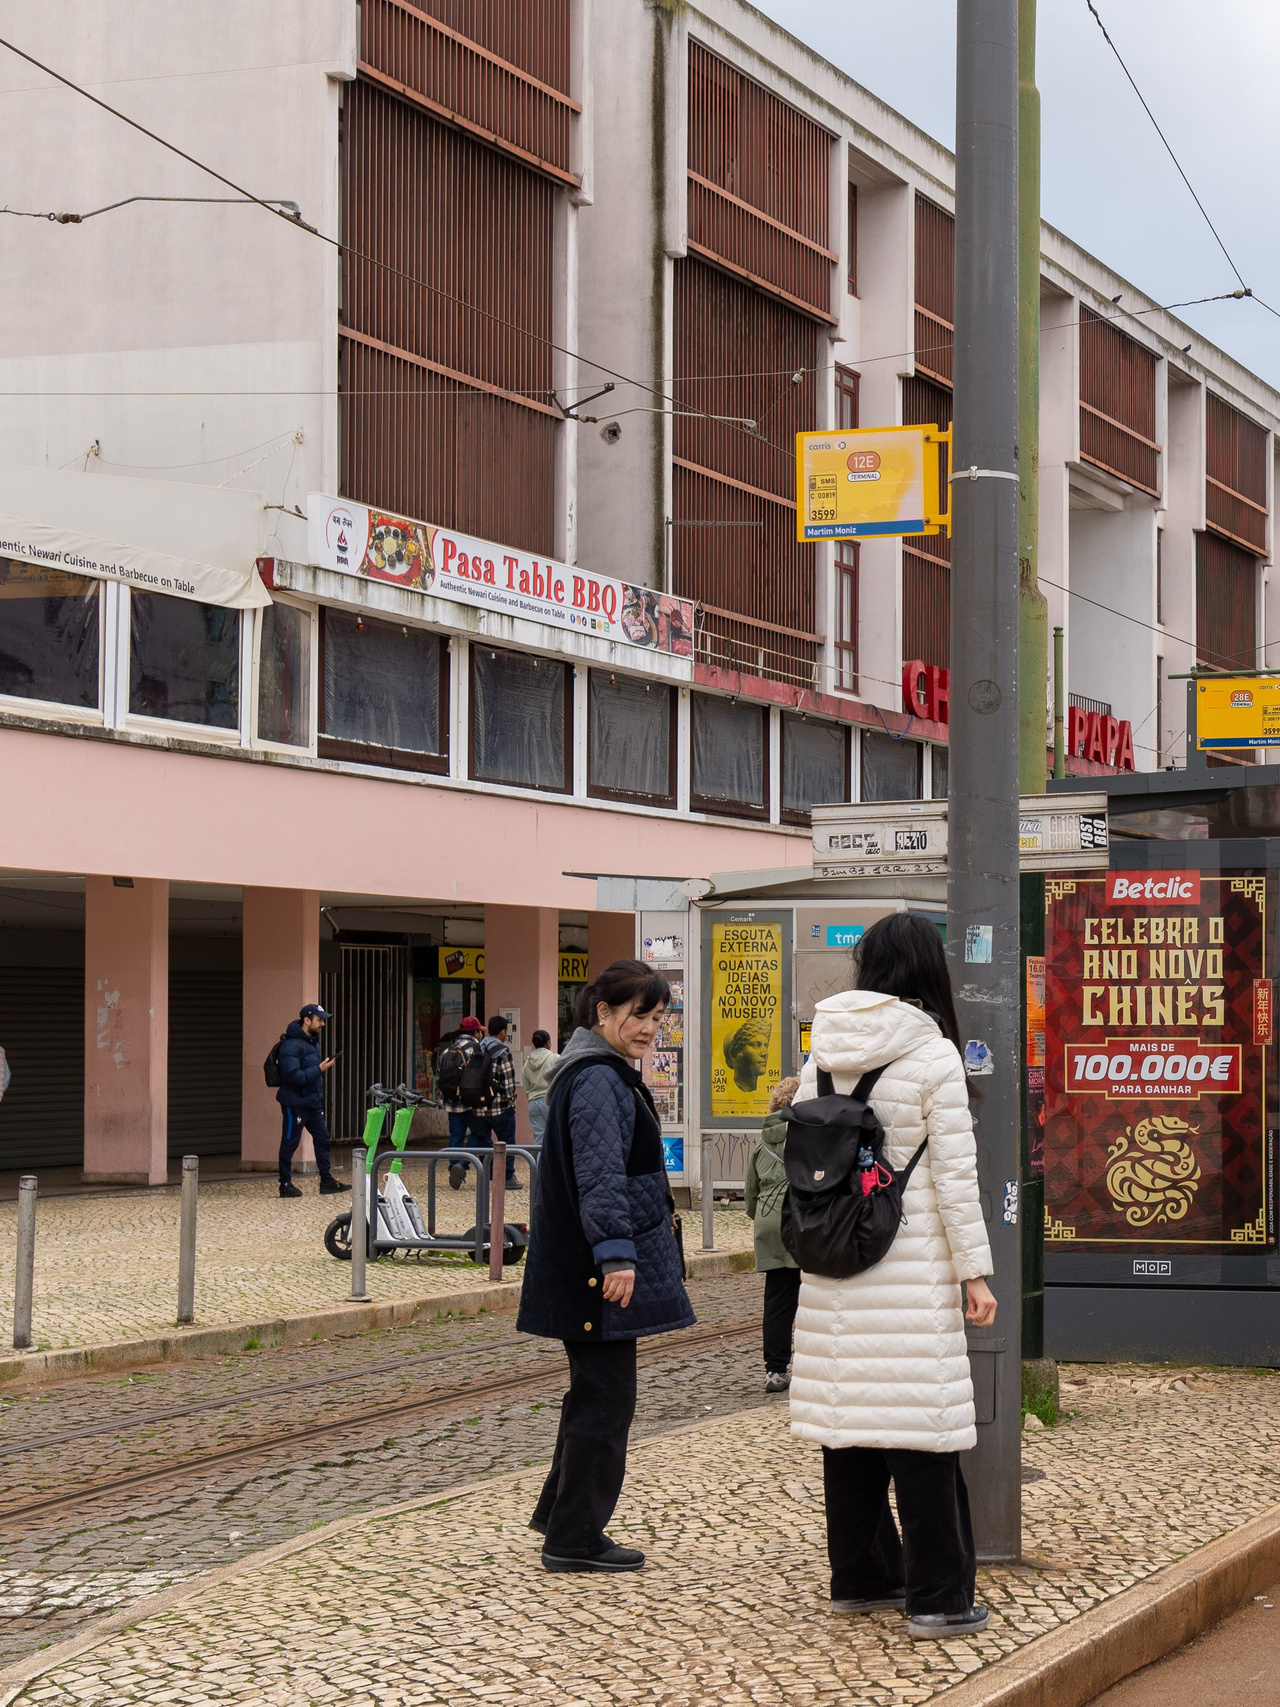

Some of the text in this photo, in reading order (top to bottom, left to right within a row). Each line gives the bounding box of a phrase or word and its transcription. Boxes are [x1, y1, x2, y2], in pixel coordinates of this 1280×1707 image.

[808, 441, 831, 451] carris
[853, 455, 875, 469] 12E
[850, 472, 879, 480] TERMINAL
[817, 491, 836, 499] 00819
[811, 509, 835, 521] 3599
[807, 526, 857, 536] Martim Moniz
[29, 544, 62, 563] Newari
[64, 553, 98, 571] Cuisine
[99, 563, 117, 575] and
[119, 565, 159, 585] Barbecue
[160, 578, 172, 588] on
[174, 578, 195, 594] Table
[441, 538, 617, 625] Pasa Table BBQ
[440, 579, 566, 620] Authentic Newari Cuisine and Barbecue on Table
[1234, 693, 1250, 701] 28E
[1263, 727, 1280, 735] 3599
[1068, 706, 1136, 771] PAPA
[1112, 876, 1194, 899] Betclic
[724, 929, 774, 941] ESCUTA
[1084, 917, 1225, 948] CELEBRA O
[720, 941, 778, 953] EXTERNA
[558, 958, 588, 978] RRY
[718, 959, 778, 971] QUANTAS
[1083, 949, 1224, 979] ANO NOVO
[728, 971, 769, 983] IDEIAS
[725, 983, 771, 995] CABEM
[718, 995, 777, 1007] NO NOVO
[1081, 978, 1225, 1026] CHINÊS
[721, 1007, 775, 1019] MUSEU?
[1256, 987, 1269, 1036] 新年快乐
[1130, 1043, 1175, 1052] MAIS DE
[714, 1069, 726, 1077] 30
[768, 1069, 780, 1077] 9H
[1073, 1054, 1233, 1081] 100.000€
[712, 1077, 727, 1085] JAN
[713, 1085, 726, 1093] '25
[1112, 1085, 1192, 1094] PARA GANHAR
[1136, 1263, 1168, 1272] MOP
